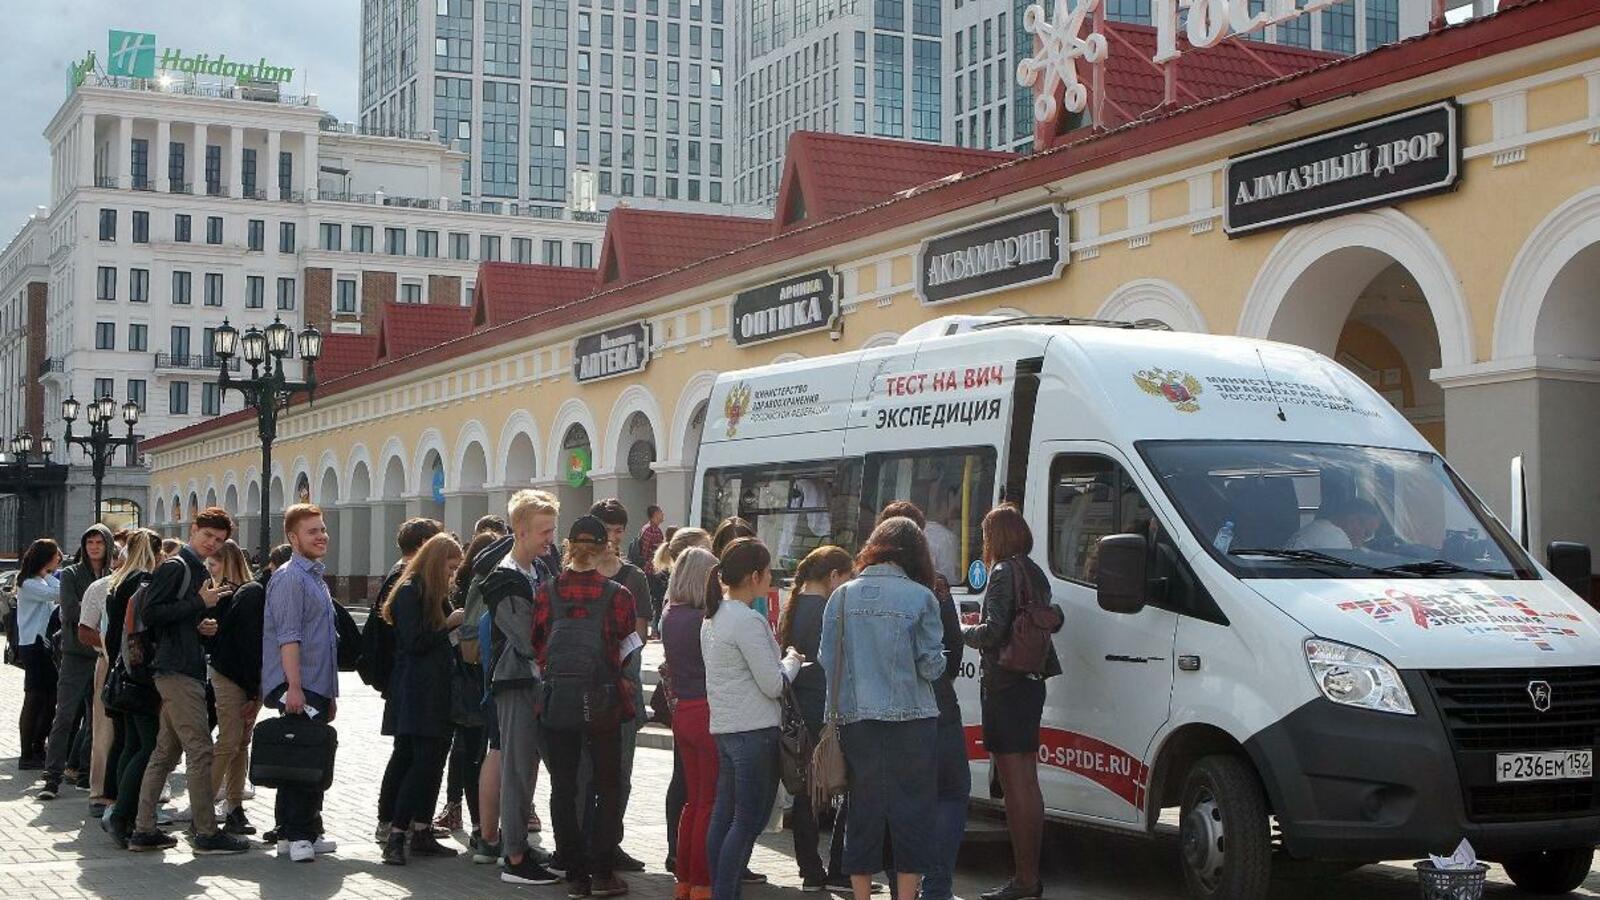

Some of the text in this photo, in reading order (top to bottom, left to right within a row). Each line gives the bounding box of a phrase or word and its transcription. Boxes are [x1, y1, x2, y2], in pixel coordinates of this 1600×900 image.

[161, 48, 251, 85] Holiday
[1235, 132, 1444, 205] АЛМАЗНЫЙ ДВОР
[928, 229, 1051, 286] АКВАМАРИН
[741, 297, 822, 338] ОПТИКА
[580, 343, 638, 379] АПТЕКА
[755, 385, 808, 398] МИНИСТЕРСТВО
[887, 365, 1003, 397] ТЕСТ НА ВИЧ
[1206, 376, 1321, 393] МИНИСТЕРСТВО
[1213, 384, 1354, 406] ЗДРАВООХРАНЕНИЯ
[875, 398, 1001, 429] ЭКСПЕДИЦИЯ
[1567, 753, 1590, 769] 152
